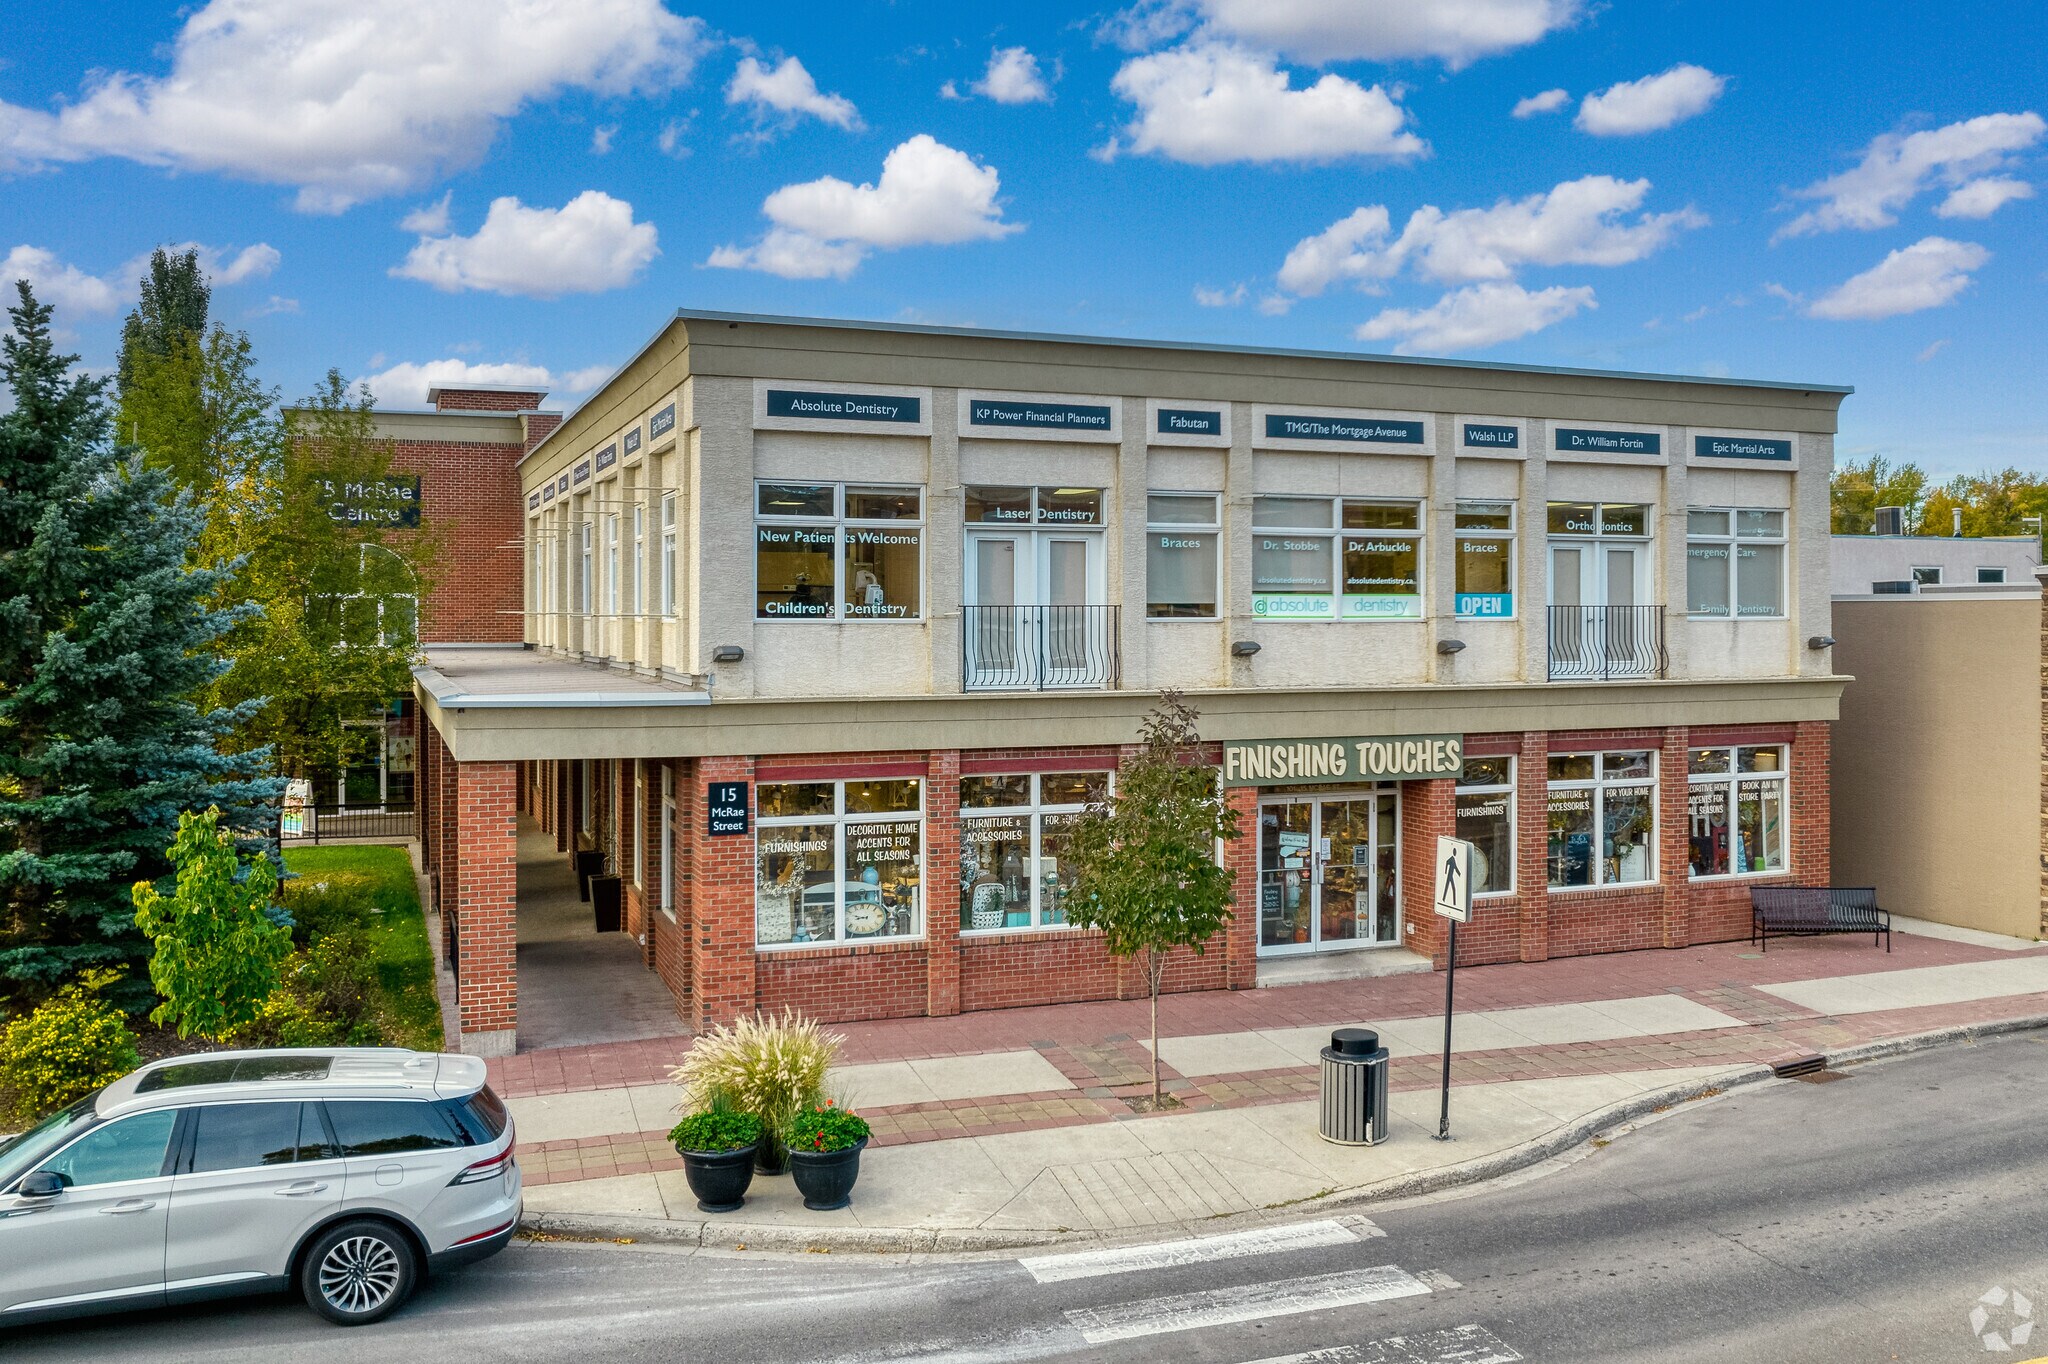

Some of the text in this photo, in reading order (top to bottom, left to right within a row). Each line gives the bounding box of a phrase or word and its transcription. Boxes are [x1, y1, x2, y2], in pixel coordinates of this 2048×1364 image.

[791, 399, 898, 418] Absolute Dentistry
[976, 408, 1105, 424] KP Power Financial Planners
[1170, 416, 1208, 429] Fabutan
[1285, 421, 1407, 438] TMG/The Mortgage Avenue
[1469, 430, 1514, 443] Walsh LLP
[1572, 435, 1644, 449] Dr. William Fortin
[1713, 442, 1775, 455] Epic Martial Arts
[315, 480, 335, 498] 5
[996, 507, 1095, 522] Laser Dentistry
[1566, 520, 1632, 532] Orthodontics
[760, 530, 918, 544] New Patients Welcome
[1161, 537, 1201, 548] Braces
[1263, 540, 1320, 551] Dr. Stobbe
[1349, 541, 1411, 553] Dr. Arbuckle
[1463, 542, 1498, 553] Braces
[1687, 548, 1756, 559] mergency Care
[1257, 576, 1327, 586] absolutedentistry.ca
[1347, 577, 1414, 586] absolutedentistry.ca
[765, 601, 907, 617] Children's Dentistry
[1270, 597, 1408, 616] absolute dentistry
[1461, 597, 1502, 614] OPEN
[1701, 604, 1775, 616] Family Dentistry
[1226, 739, 1461, 781] FINISHING TOUCHES
[1688, 782, 1729, 793] CORITIVE HOME
[1742, 780, 1779, 790] BOOK AN IN
[722, 787, 737, 802] 15
[1548, 790, 1582, 800] FURNITURE
[1606, 787, 1649, 797] FOR YOUR HOME
[1739, 791, 1782, 801] STORE PARTY
[1688, 793, 1724, 804] ACCENTS FOR
[711, 807, 744, 817] McRae
[1457, 805, 1504, 818] FURNISHINGS
[1547, 801, 1589, 811] ACCESSORIES
[1688, 805, 1723, 815] ALL SEASONS
[713, 821, 743, 831] Street
[967, 817, 1021, 829] FURNITURE &
[1045, 815, 1059, 825] FOR
[847, 823, 918, 836] DECORITIVE HOME
[966, 830, 1023, 842] ACCESSORIES
[765, 840, 827, 854] FURNISHINGS
[857, 836, 910, 849] ACCENTS FOR
[856, 849, 910, 862] ALL SEASONS
